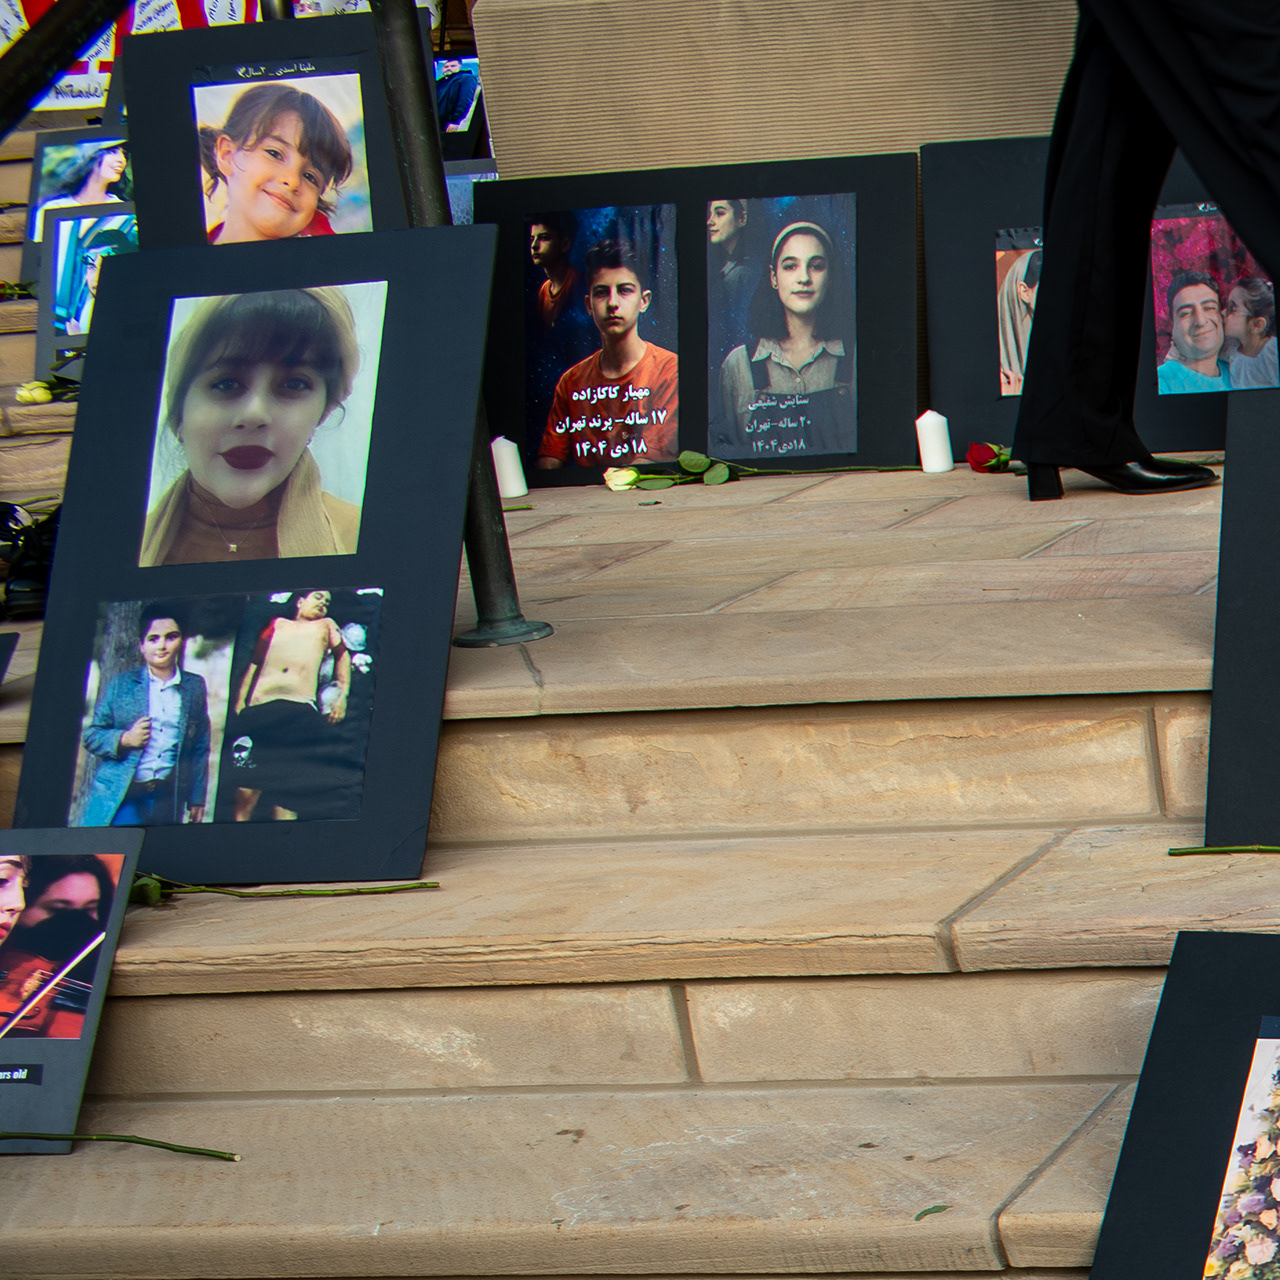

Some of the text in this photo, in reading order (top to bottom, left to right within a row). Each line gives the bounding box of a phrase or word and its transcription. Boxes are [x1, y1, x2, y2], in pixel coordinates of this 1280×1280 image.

[571, 384, 651, 405] مهیار کاکازاده
[747, 394, 810, 411] ستایش شفیعی
[555, 415, 587, 434] تهران
[588, 414, 613, 431] پرند
[651, 409, 667, 425] ۱۷
[12, 1068, 28, 1080] old
